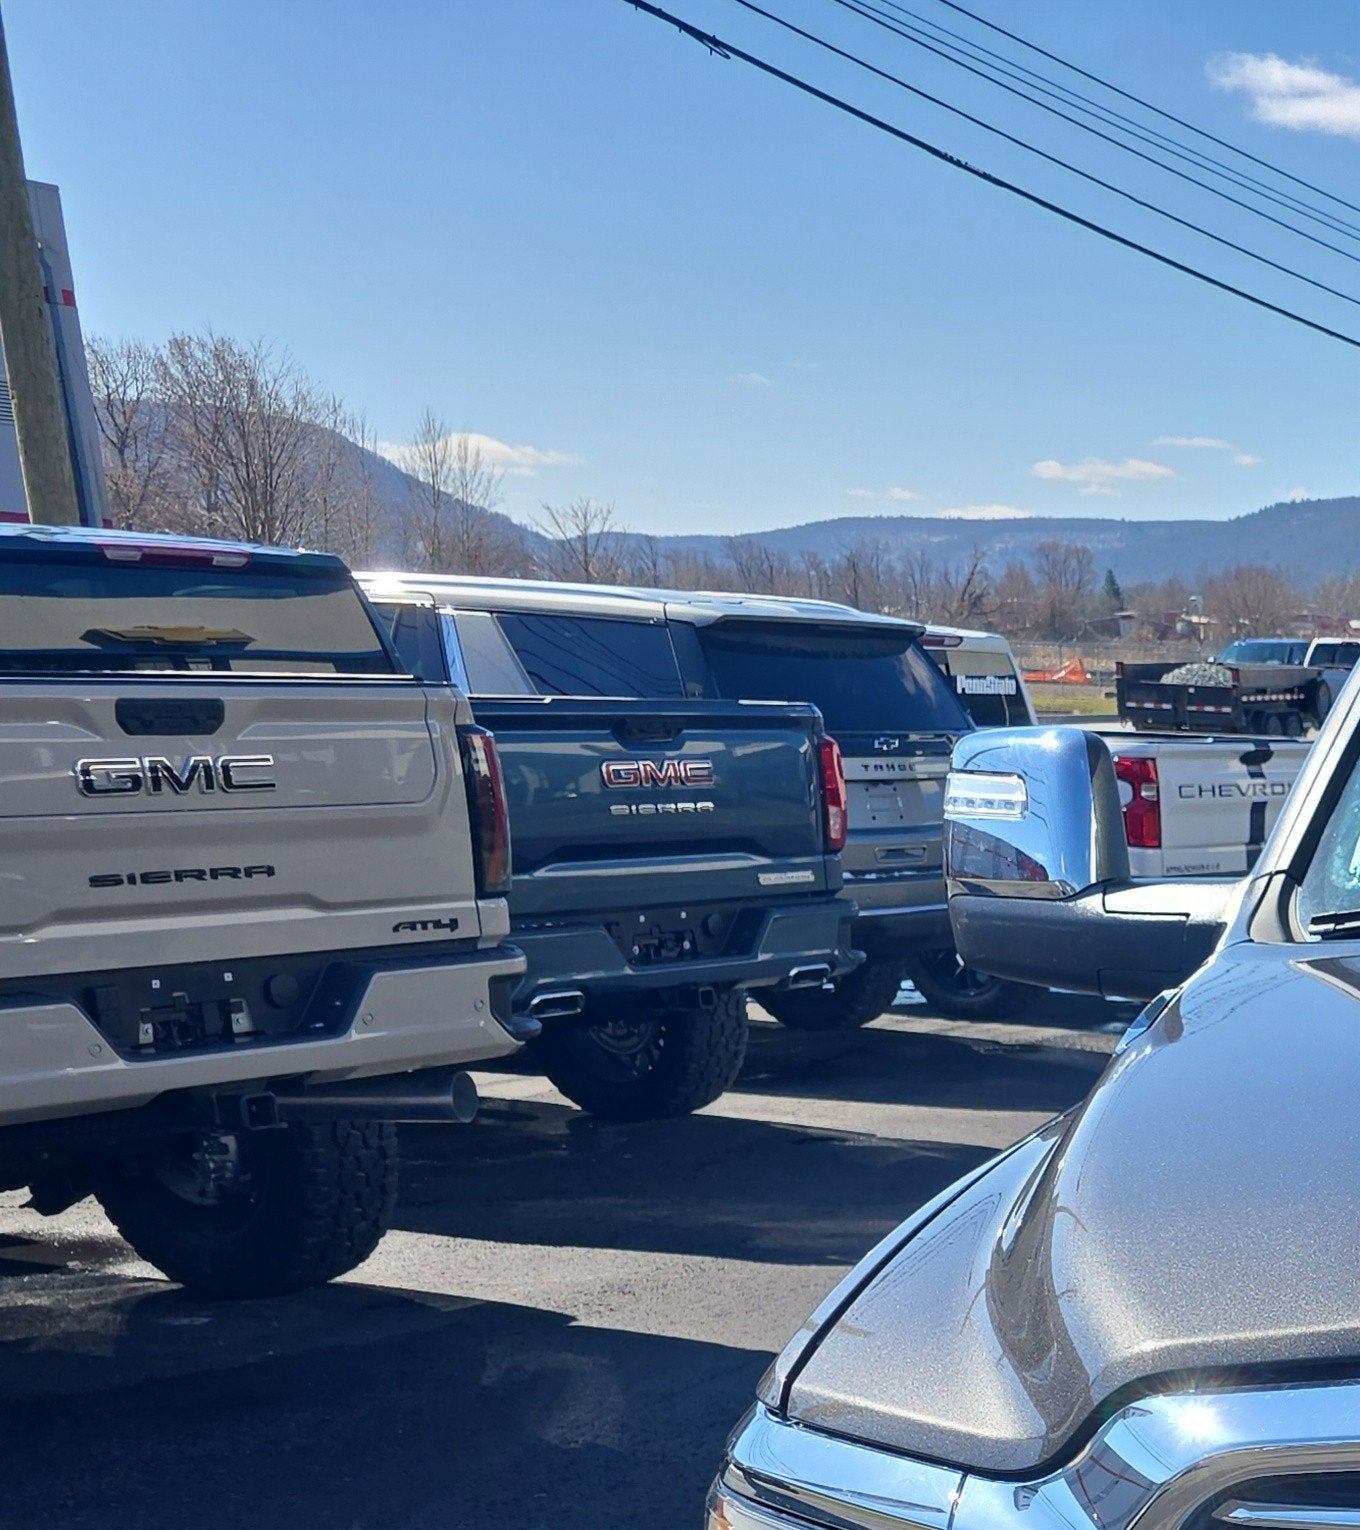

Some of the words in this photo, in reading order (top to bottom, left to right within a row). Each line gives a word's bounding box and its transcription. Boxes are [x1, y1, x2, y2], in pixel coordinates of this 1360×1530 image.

[75, 754, 277, 797] GMC
[601, 759, 715, 789] GMC
[1178, 782, 1292, 799] CHEVRO
[610, 801, 715, 815] SIERRA
[88, 865, 276, 888] SIERRA
[392, 917, 459, 933] AT4
